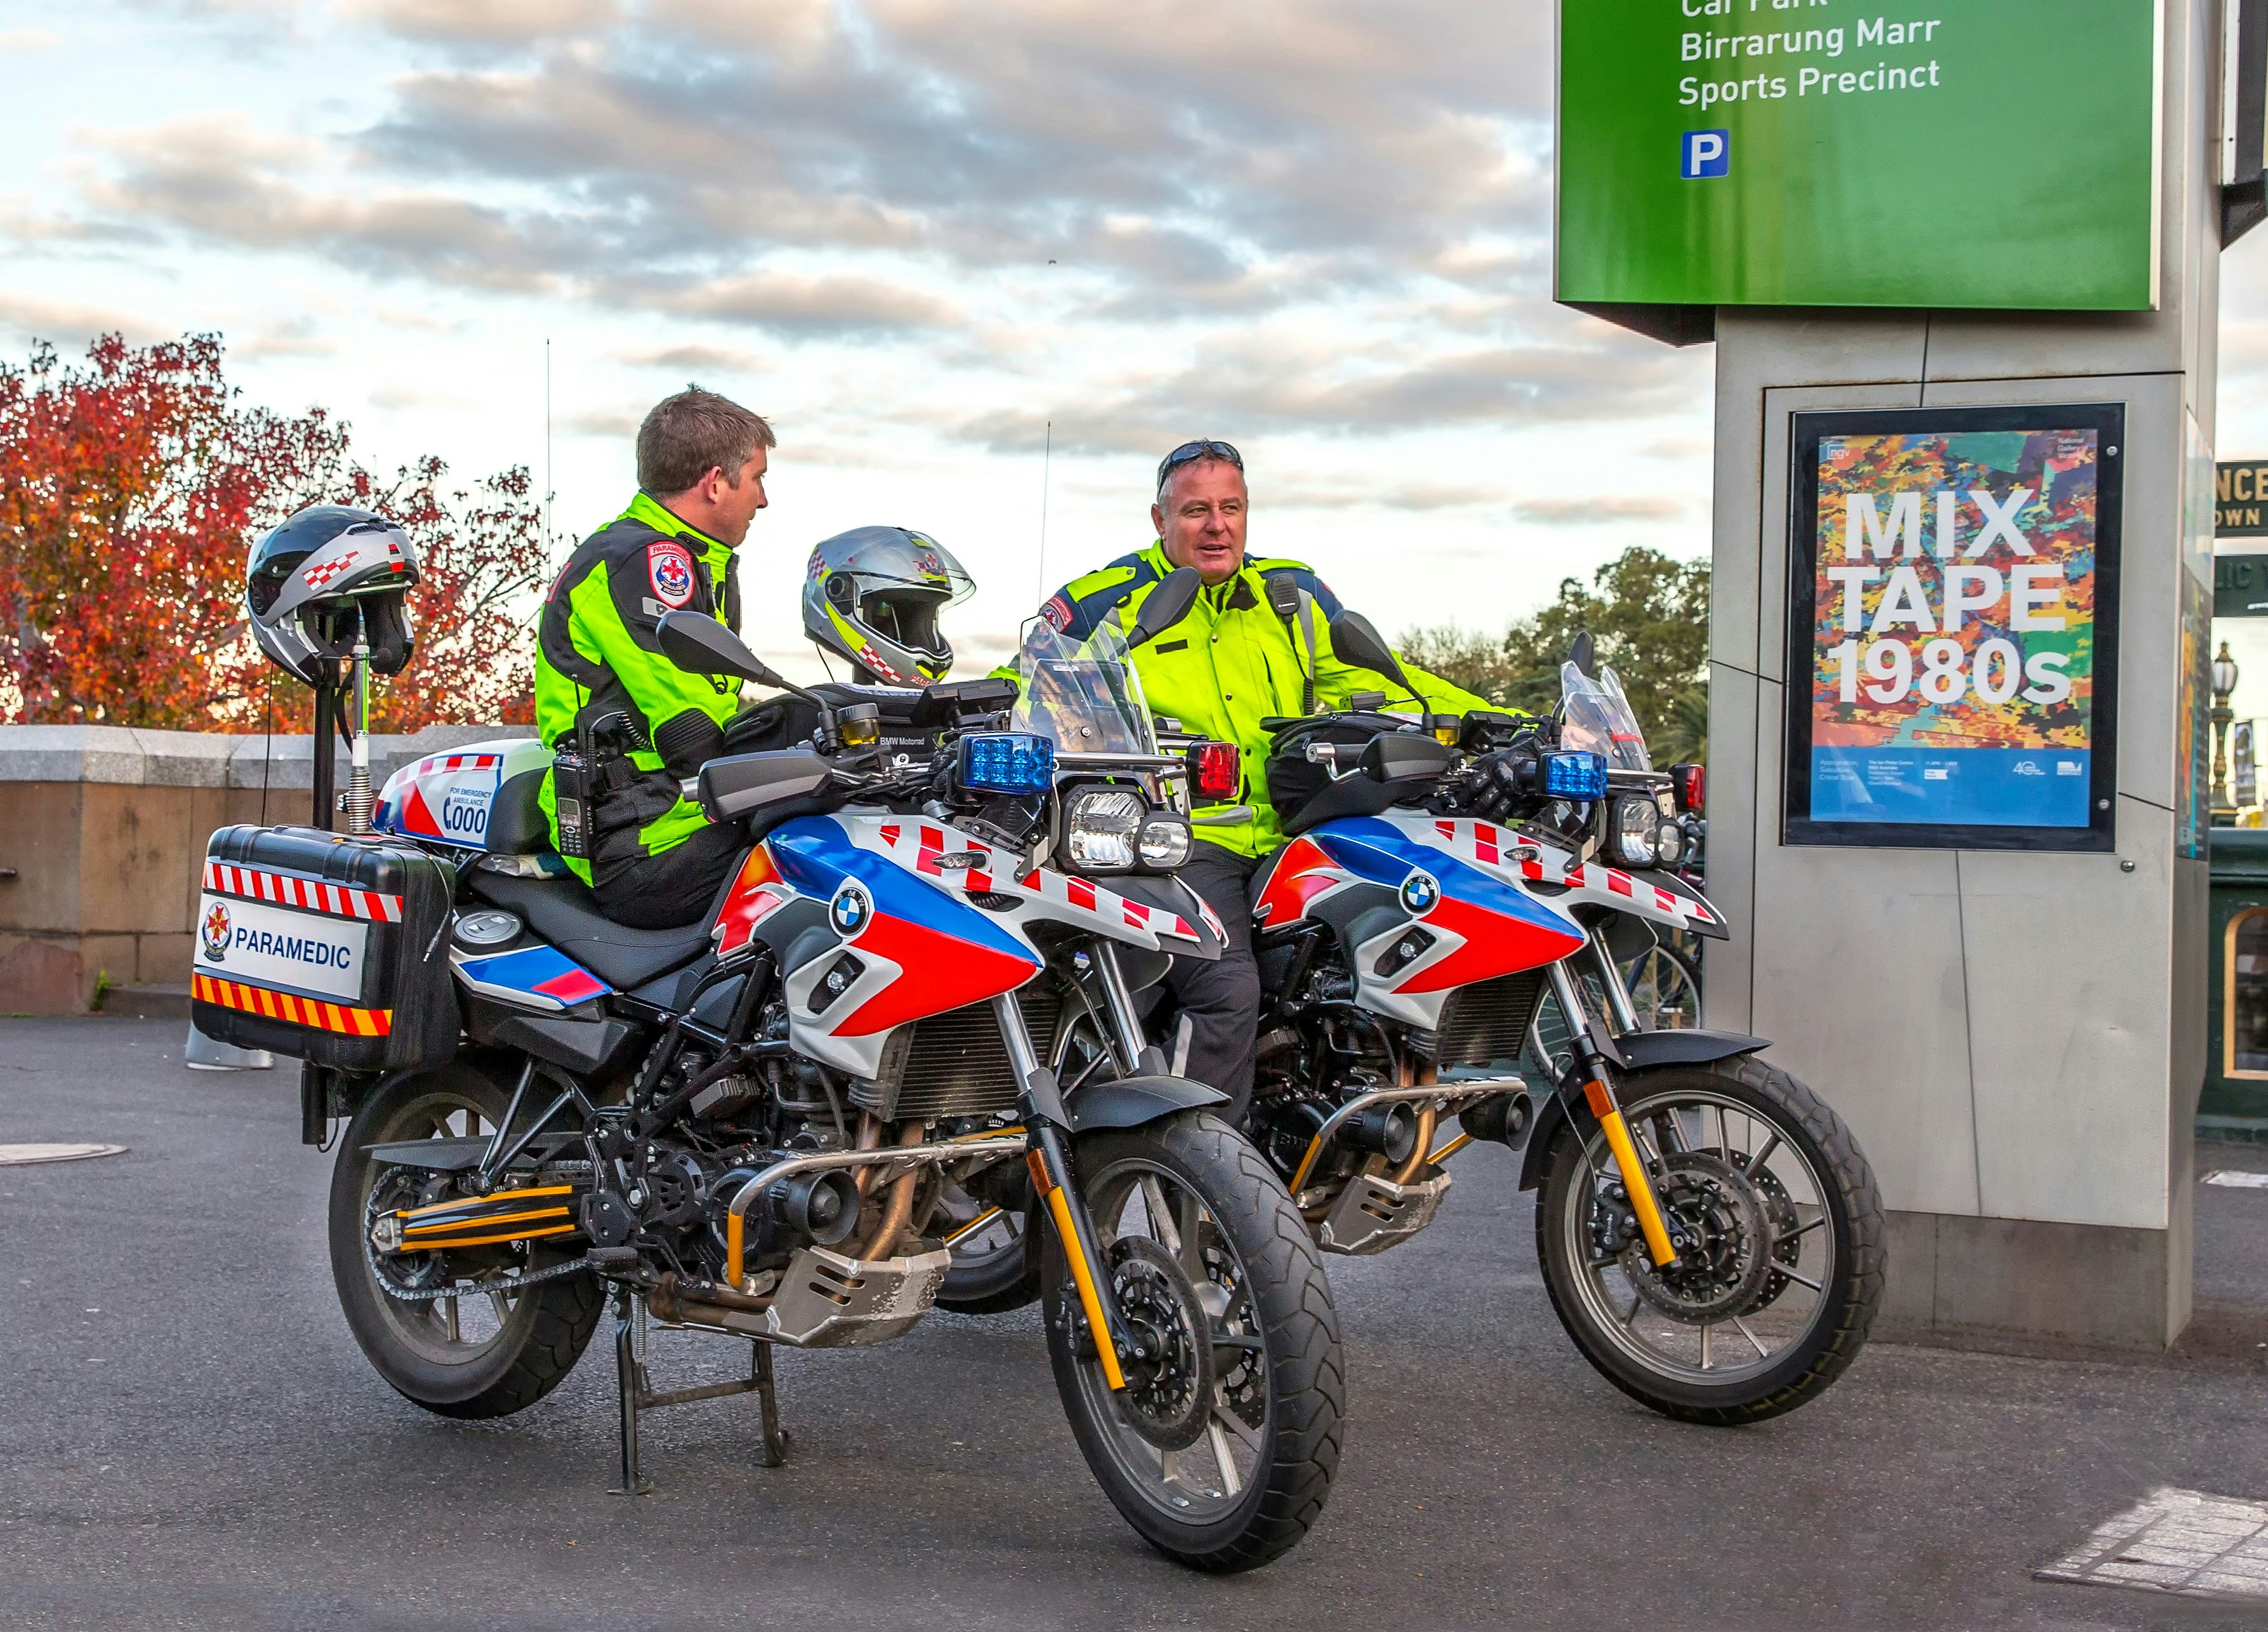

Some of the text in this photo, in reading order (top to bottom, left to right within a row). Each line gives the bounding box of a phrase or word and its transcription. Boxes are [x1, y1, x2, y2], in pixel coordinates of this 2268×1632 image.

[1681, 16, 1941, 62] Birrarung Marr
[1678, 60, 1940, 111] Sports Precinct
[1690, 133, 1724, 176] P
[1844, 488, 2037, 560] MIX
[1826, 562, 2066, 633] TAPE
[1827, 637, 2072, 705] 1980s
[880, 736, 925, 745] BMW Motorrad
[452, 796, 485, 807] AMBULANCE
[460, 788, 492, 799] EMERGENCY
[452, 805, 486, 834] 000
[836, 889, 866, 907] BMW
[1406, 877, 1435, 890] BMW
[235, 927, 352, 970] PARAMEDIC
